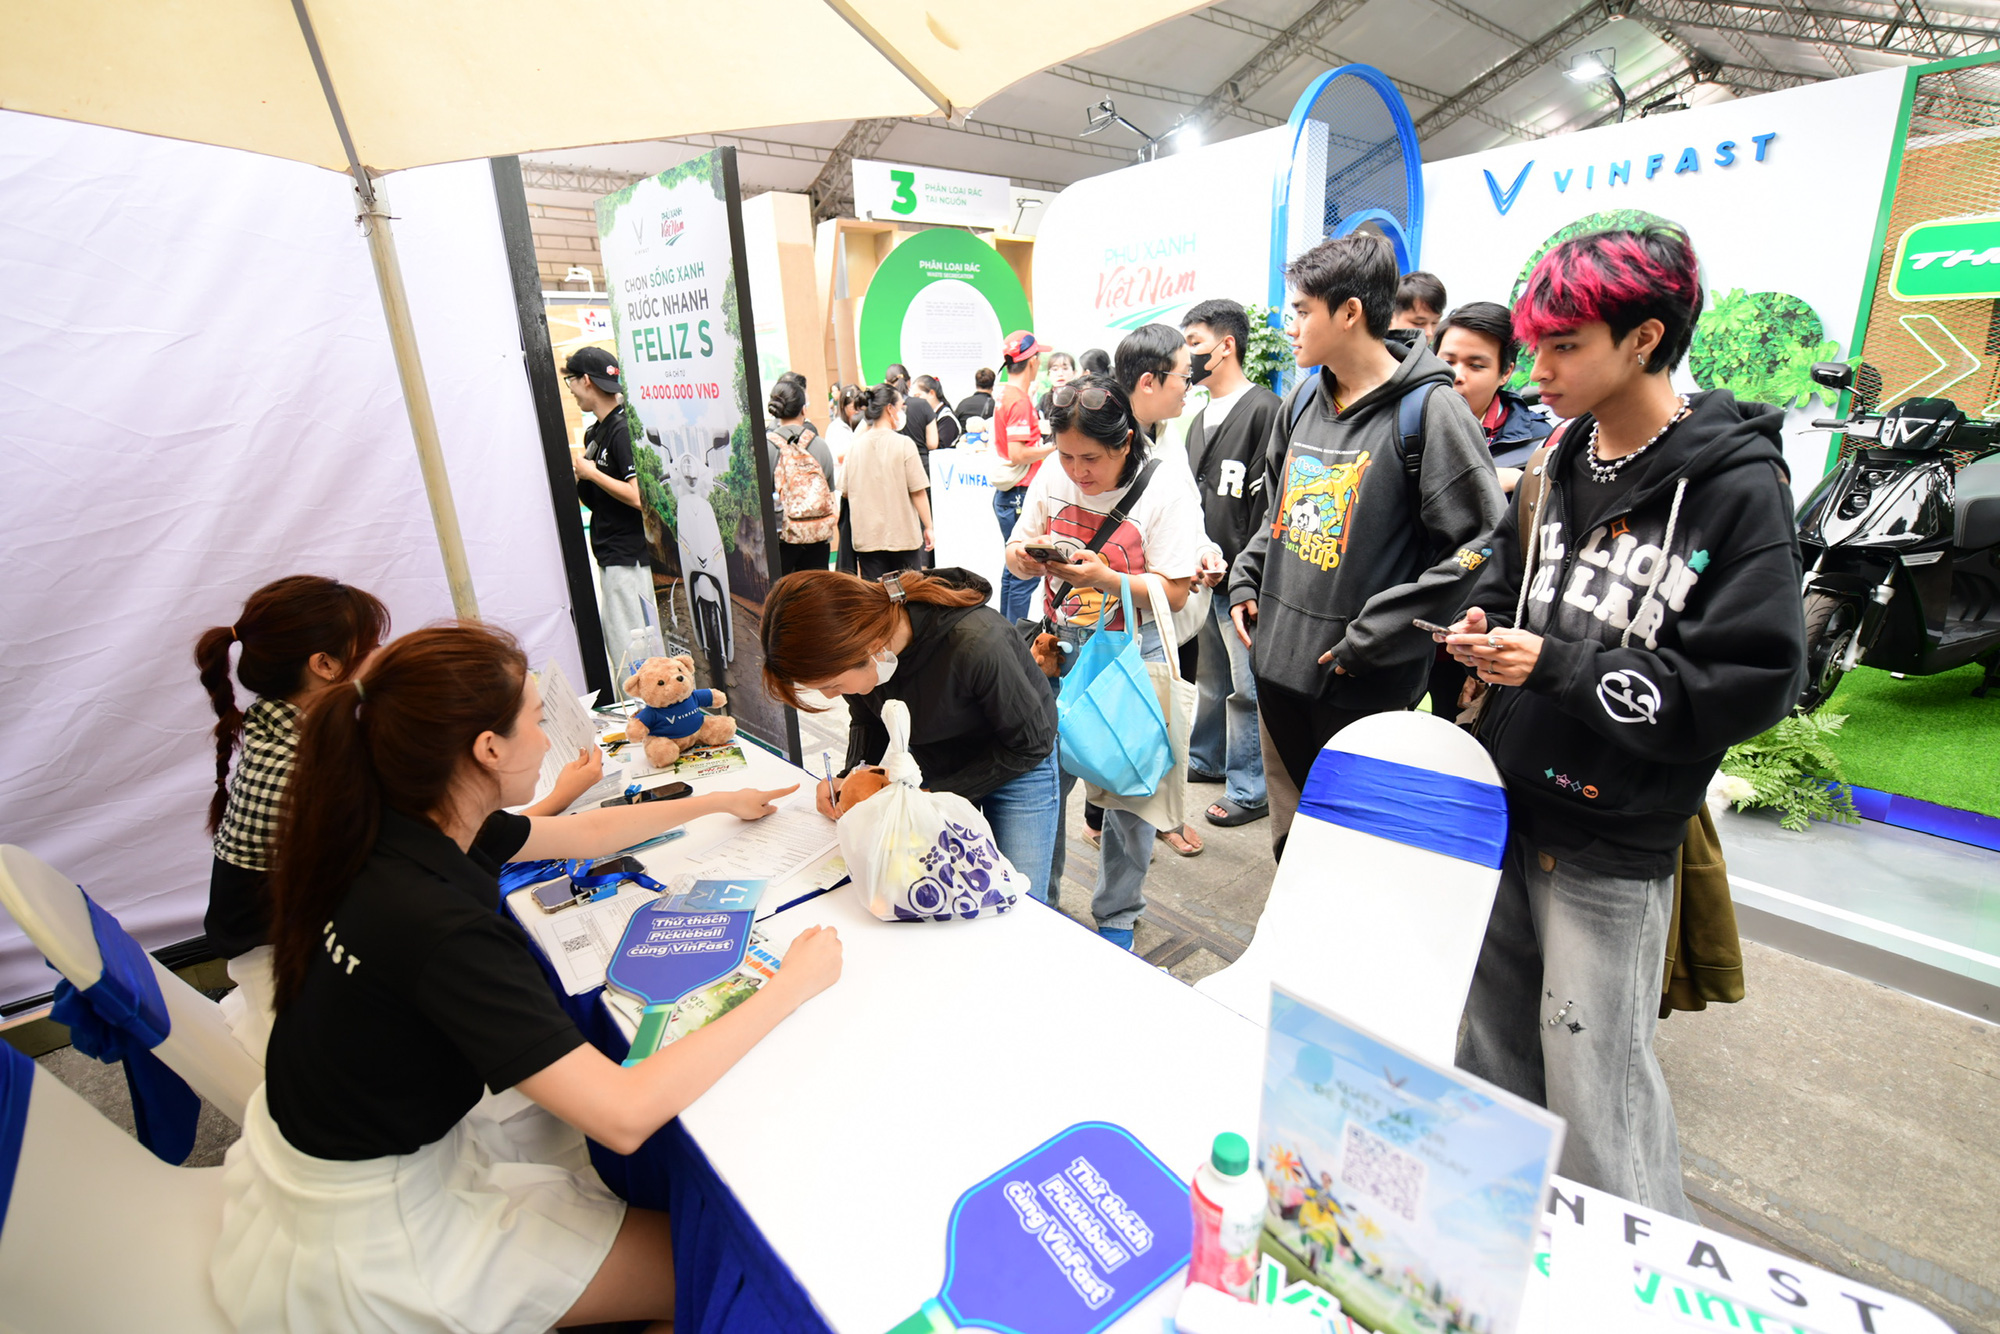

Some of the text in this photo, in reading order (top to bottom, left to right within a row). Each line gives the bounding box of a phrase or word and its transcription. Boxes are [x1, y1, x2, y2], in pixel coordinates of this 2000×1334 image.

[1554, 132, 1776, 193] VINFAST
[890, 169, 918, 215] 3
[1143, 232, 1196, 261] XANH
[625, 261, 705, 295] CHỌN SỐNG XANH
[919, 259, 943, 271] PHÂN
[964, 262, 981, 272] RÁC
[627, 288, 709, 321] RƯỚC NHANH
[1095, 266, 1196, 317] Việt Nam
[631, 319, 714, 363] FELIZ S
[640, 382, 720, 400] 24.000.000 VNĐ
[958, 472, 994, 488] VINFA
[1289, 526, 1338, 553] cusa
[1298, 545, 1340, 572] cup
[719, 884, 749, 904] 17
[649, 927, 723, 942] Pickleball
[686, 914, 728, 926] thách
[630, 941, 730, 957] cùng VinFast
[1044, 1177, 1124, 1267] Pickleball
[1099, 1195, 1149, 1251] thách
[1008, 1184, 1107, 1304] cùng VinFast
